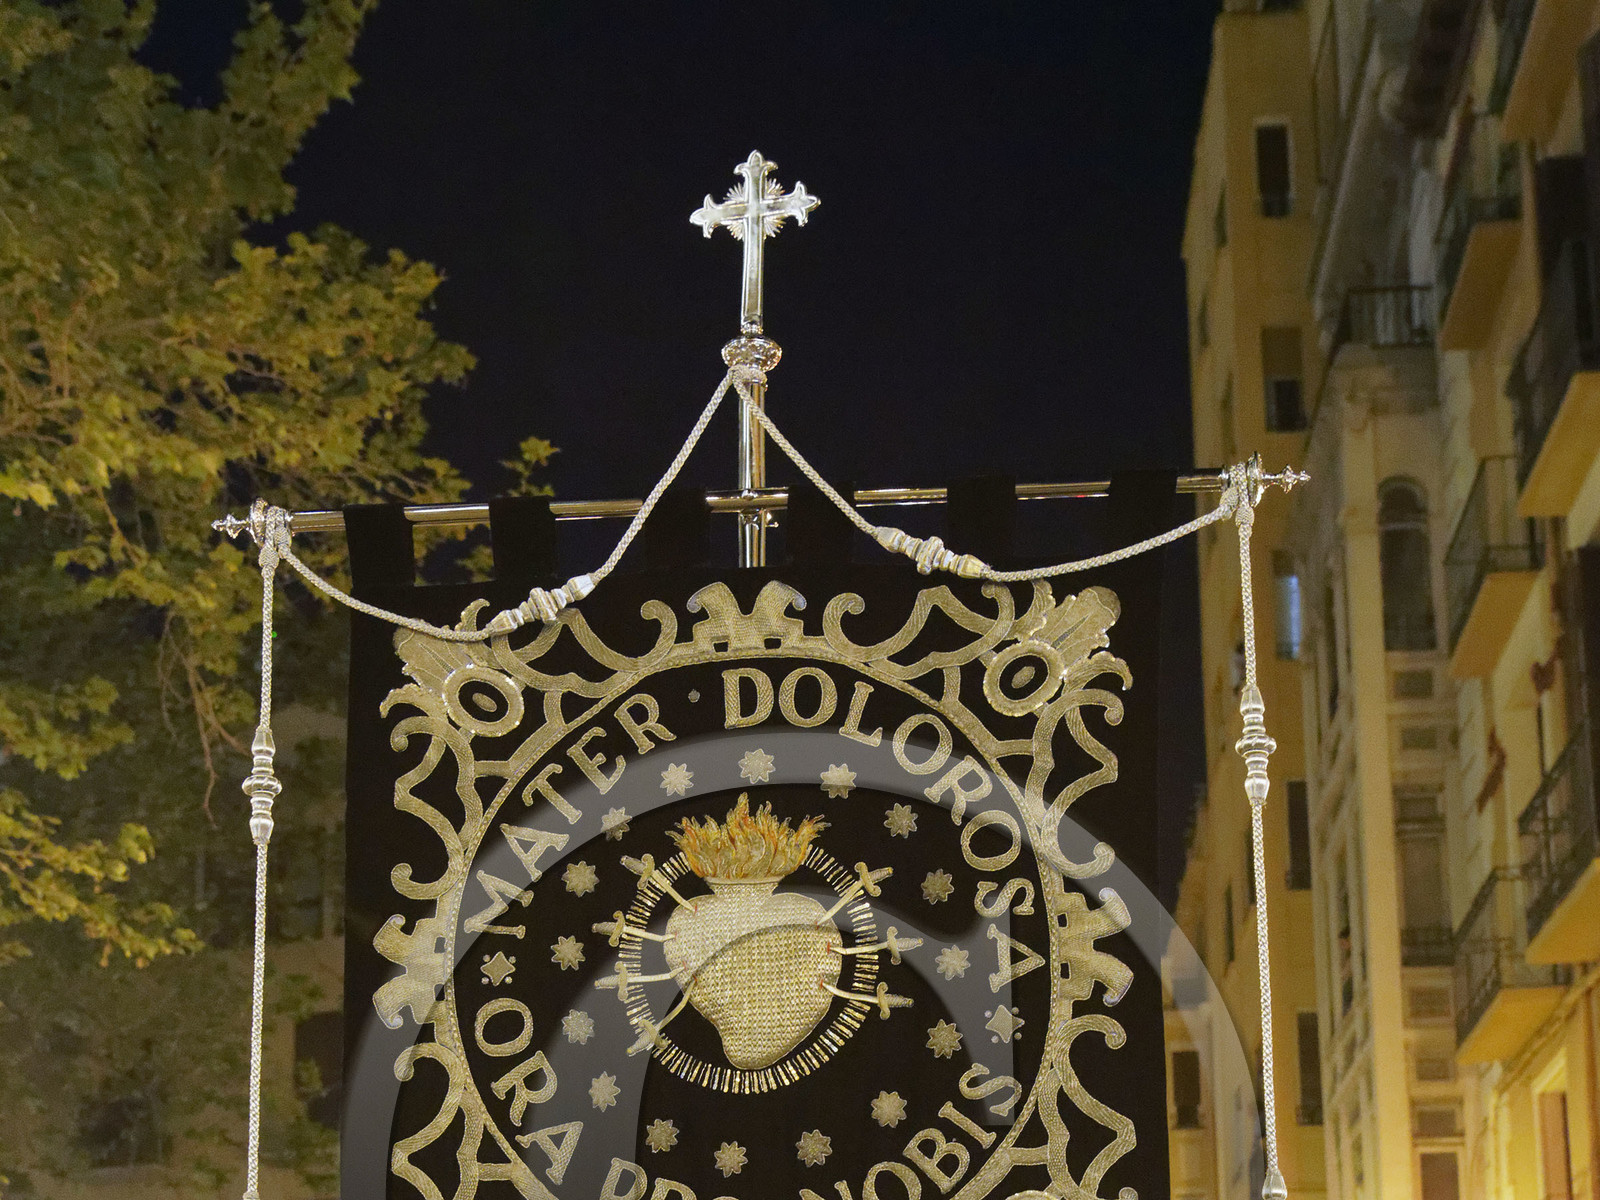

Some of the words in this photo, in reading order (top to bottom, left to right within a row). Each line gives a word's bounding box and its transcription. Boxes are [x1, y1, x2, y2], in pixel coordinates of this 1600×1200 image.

[464, 693, 677, 940] MATER
[722, 666, 1046, 993] DOLOROSA
[474, 997, 584, 1186] ORA
